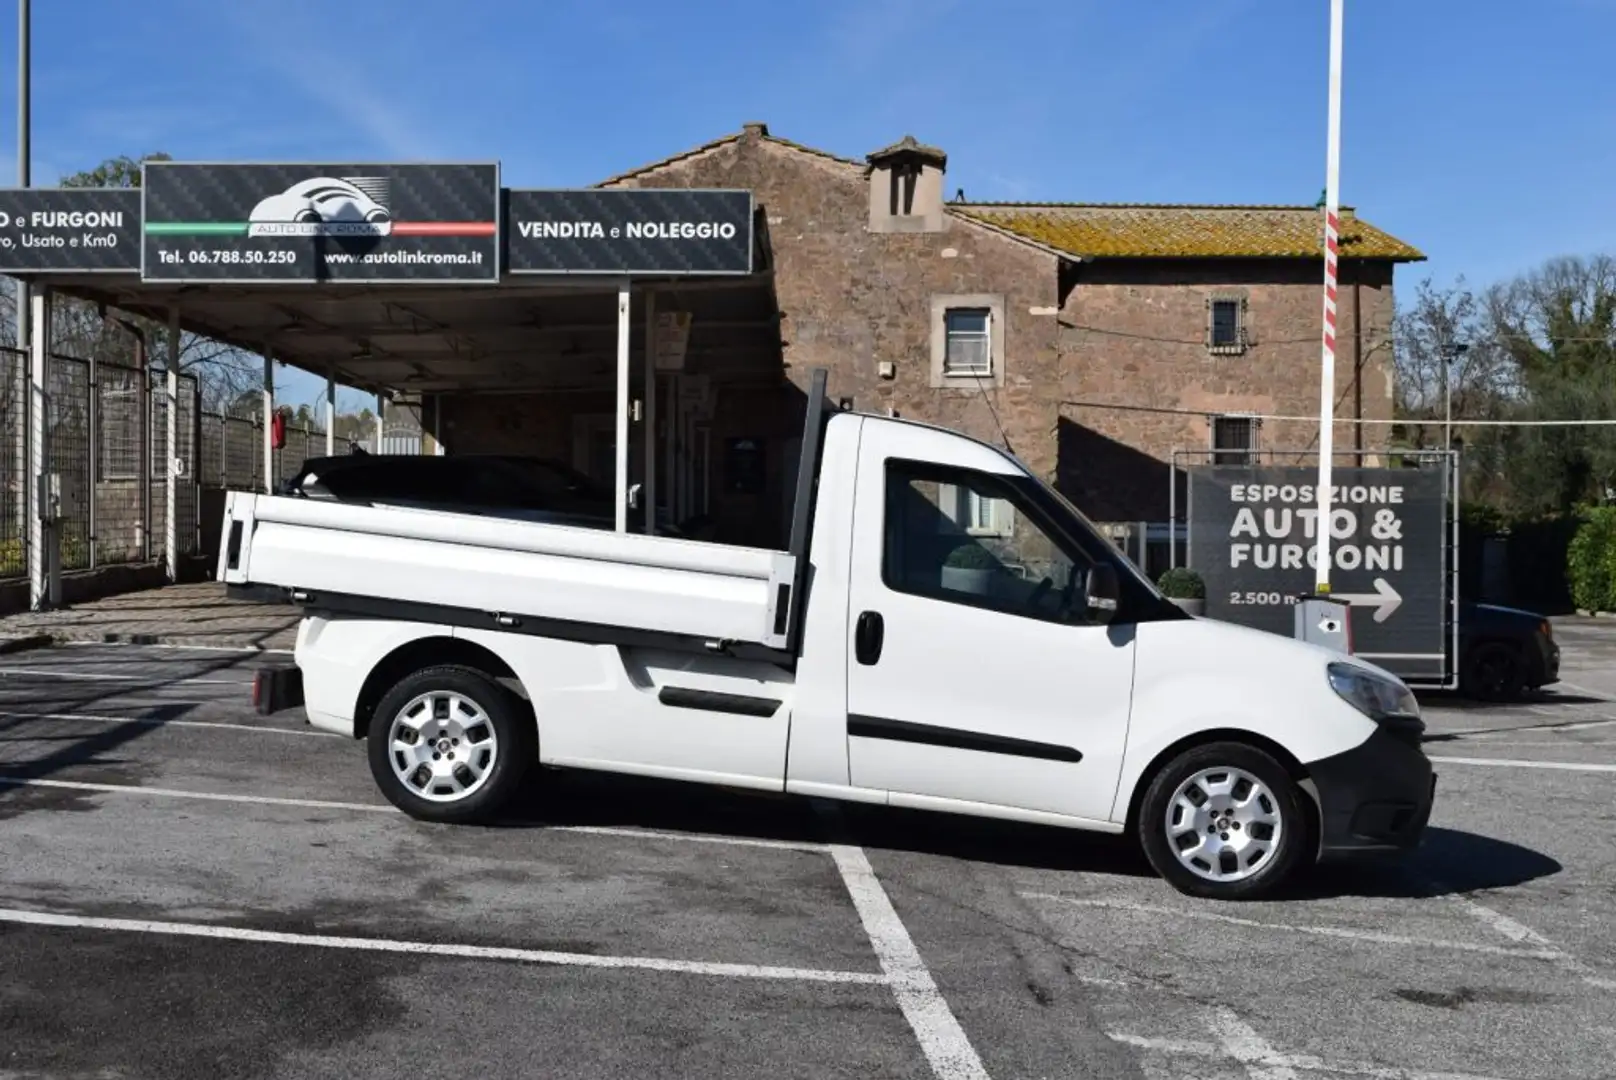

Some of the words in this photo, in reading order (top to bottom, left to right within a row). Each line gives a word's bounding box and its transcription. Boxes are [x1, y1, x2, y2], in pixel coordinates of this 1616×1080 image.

[15, 216, 25, 228] e
[31, 211, 123, 228] FURGONI
[257, 224, 296, 233] AUTO
[301, 224, 332, 233] LINK
[336, 223, 382, 233] ROMA
[518, 221, 605, 238] VENDITA
[610, 226, 620, 238] e
[626, 221, 736, 238] NOLEGGIO
[0, 236, 17, 251] o,
[22, 232, 65, 248] Usato
[69, 236, 79, 248] e
[83, 232, 118, 248] Km0
[158, 250, 184, 263] Tel.
[188, 250, 296, 264] 06.788.50.250
[324, 250, 483, 264] www.autolinkroma.it
[1229, 507, 1357, 540] AUTO
[1371, 508, 1404, 540] &
[1230, 543, 1404, 571] FURGONI
[1230, 592, 1281, 605] 2.500
